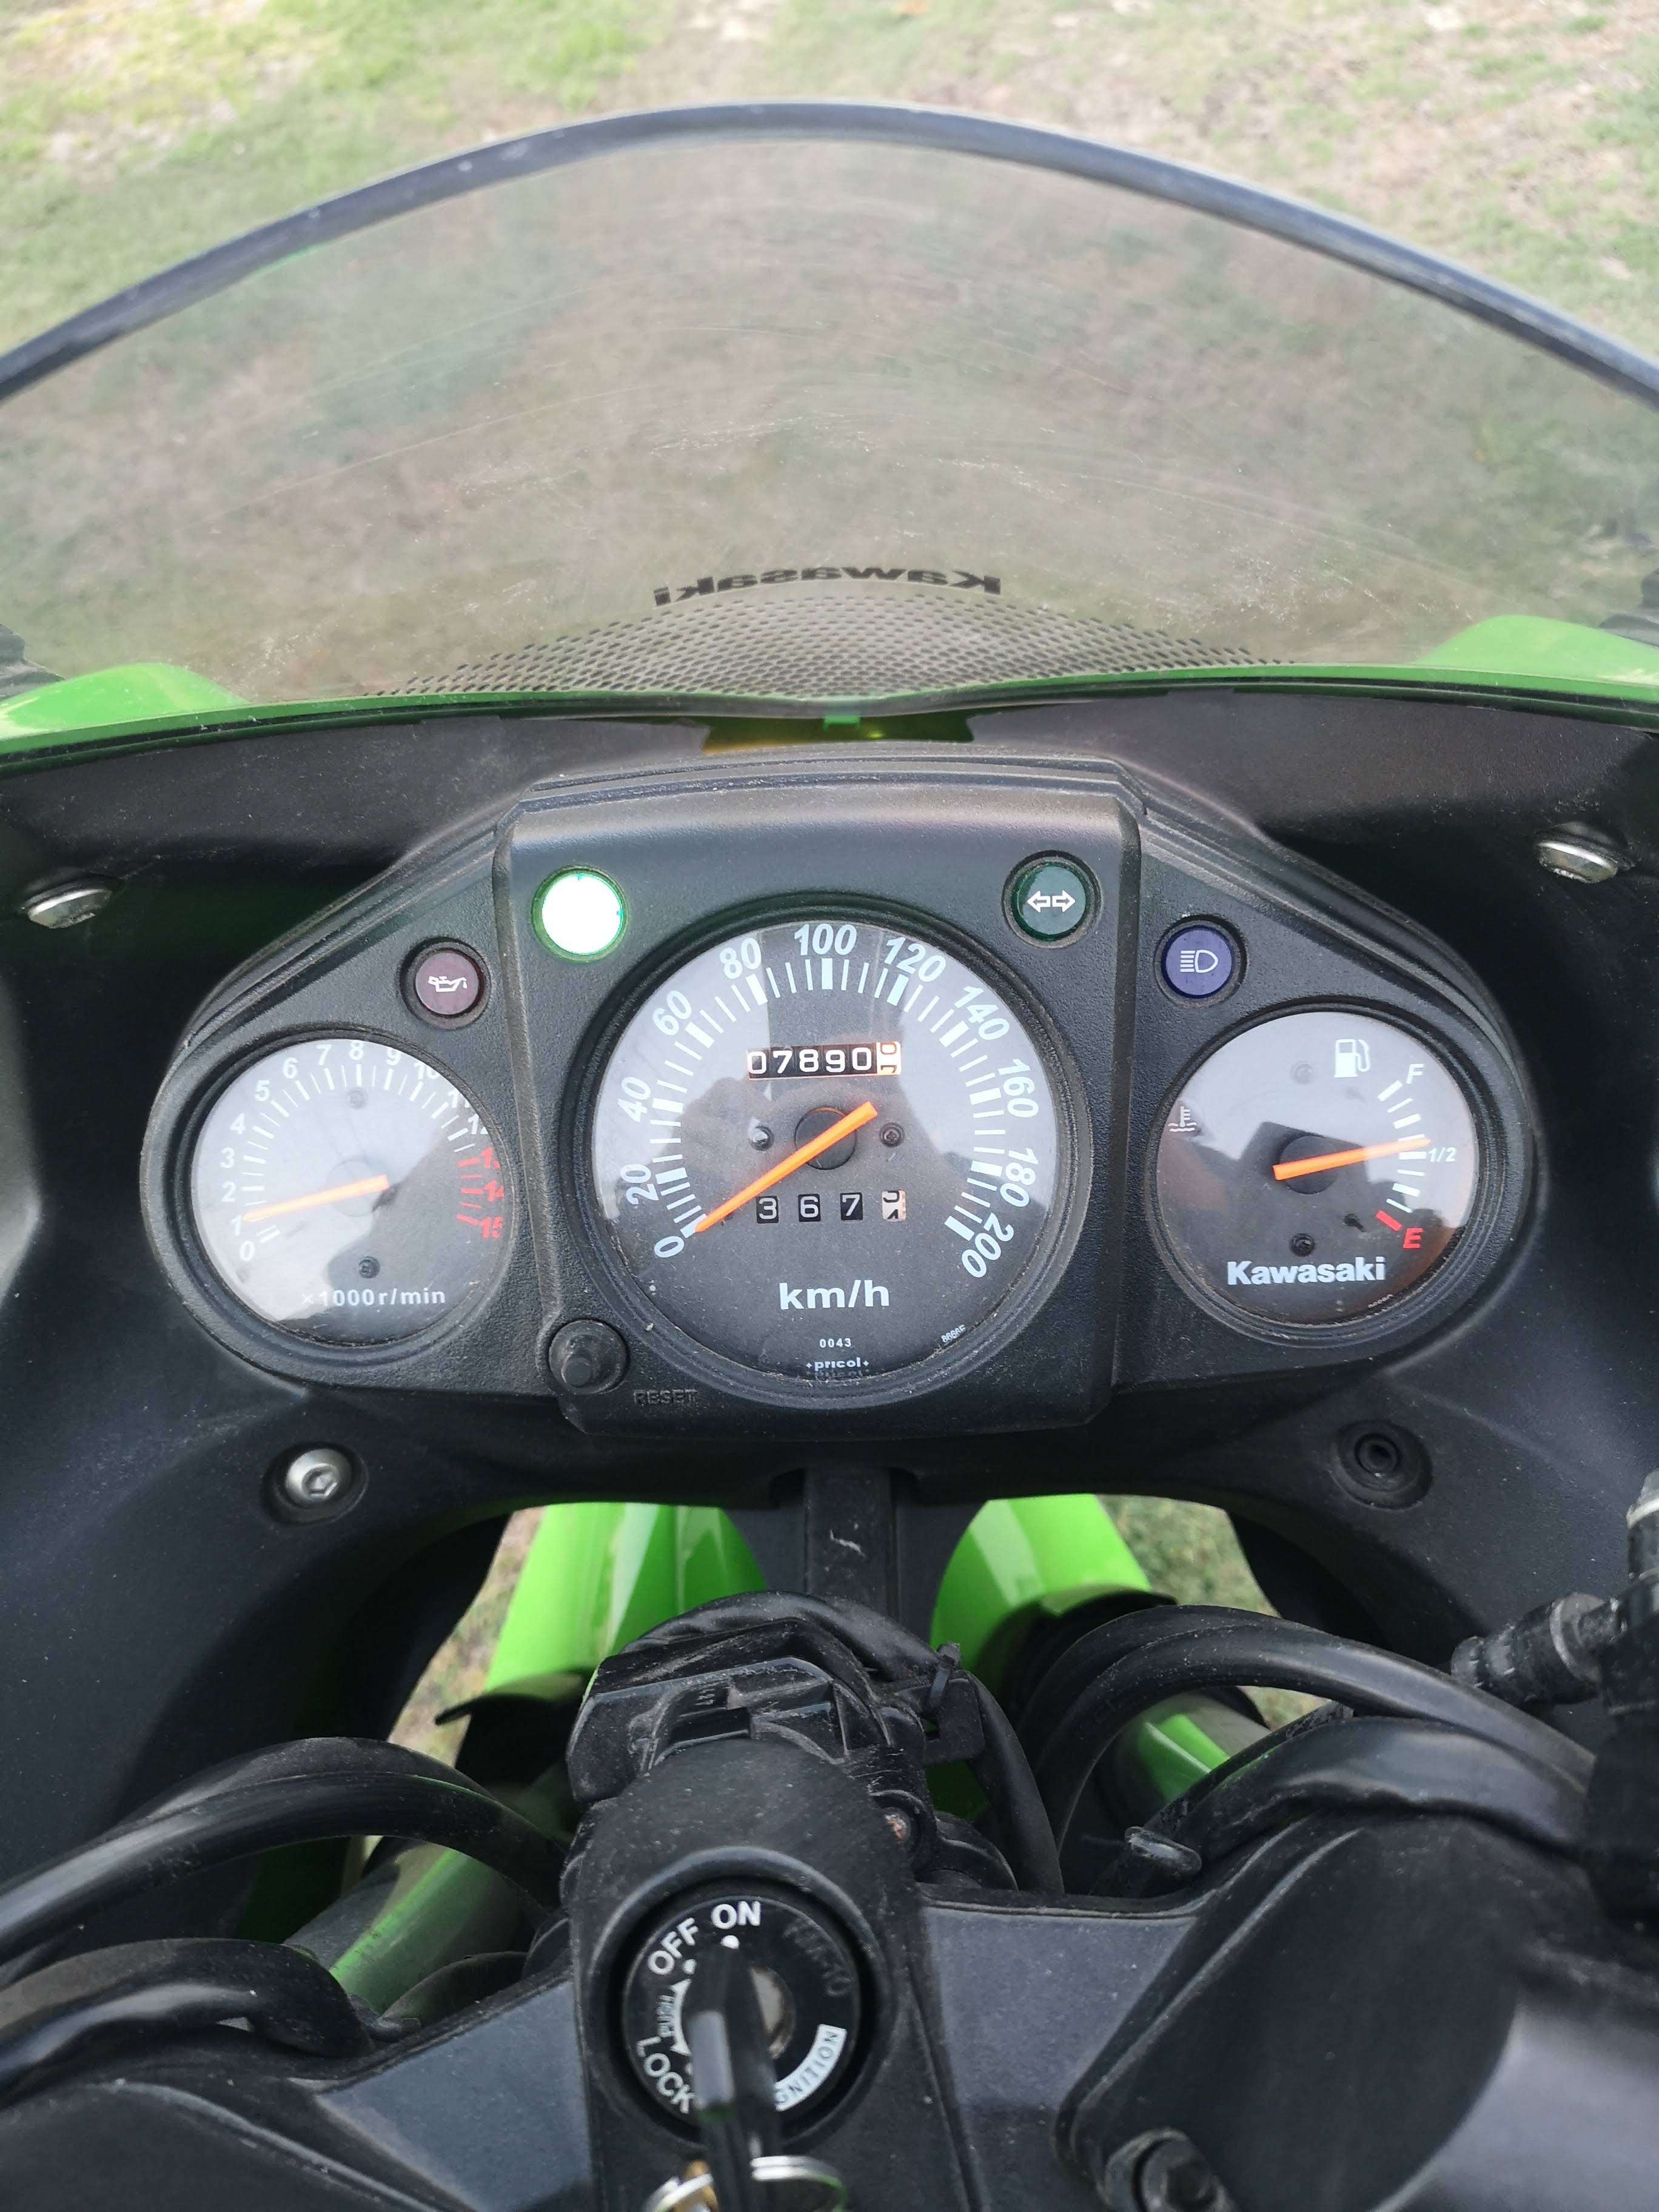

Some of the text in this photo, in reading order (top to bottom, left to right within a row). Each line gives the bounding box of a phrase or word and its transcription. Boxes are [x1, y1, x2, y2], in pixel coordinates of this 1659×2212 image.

[794, 923, 857, 955] 100
[720, 938, 762, 979] 80
[885, 937, 947, 983] 120
[652, 990, 691, 1036] 60
[955, 987, 1010, 1041] 140
[317, 1044, 332, 1065] 7
[349, 1040, 364, 1060] 8
[386, 1047, 401, 1065] 9
[283, 1057, 298, 1079] 6
[1406, 1062, 1424, 1084] F
[255, 1080, 270, 1102] 5
[622, 1077, 651, 1123] 40
[999, 1059, 1039, 1118] 160
[230, 1113, 247, 1134] 4
[220, 1148, 235, 1168] 3
[1429, 1147, 1456, 1163] 1/2
[622, 1164, 659, 1205] 20
[1000, 1148, 1039, 1208] 180
[222, 1182, 236, 1203] 2
[231, 1215, 242, 1236] 1
[654, 1236, 685, 1259] 0
[961, 1212, 1014, 1278] 200
[1403, 1227, 1424, 1249] E
[240, 1241, 255, 1261] 0
[1227, 1256, 1386, 1285] Kawasaki
[779, 1280, 890, 1310] km/h
[819, 1338, 852, 1349] 0043
[633, 1388, 699, 1406] RESET
[711, 1900, 761, 1929] ON
[647, 1917, 699, 1976] OFF
[636, 2036, 696, 2114] LOCK
